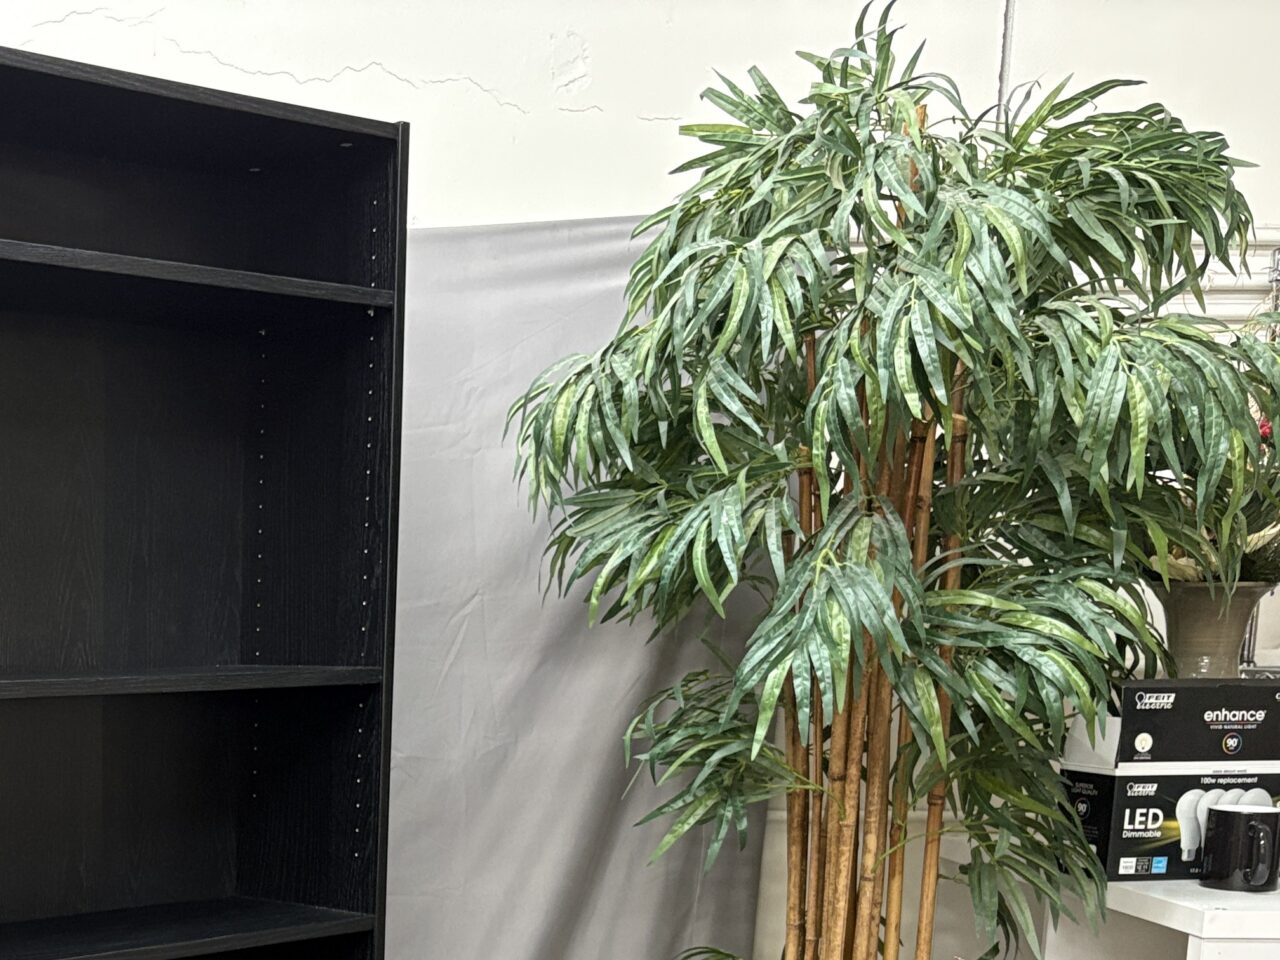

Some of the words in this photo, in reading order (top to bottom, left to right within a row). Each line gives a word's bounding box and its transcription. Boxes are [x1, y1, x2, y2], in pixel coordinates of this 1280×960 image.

[1145, 693, 1175, 702] FEIT
[1204, 707, 1266, 722] enhance
[1218, 776, 1258, 784] replacement
[1123, 808, 1164, 830] LED
[1122, 830, 1162, 838] Dimmable
